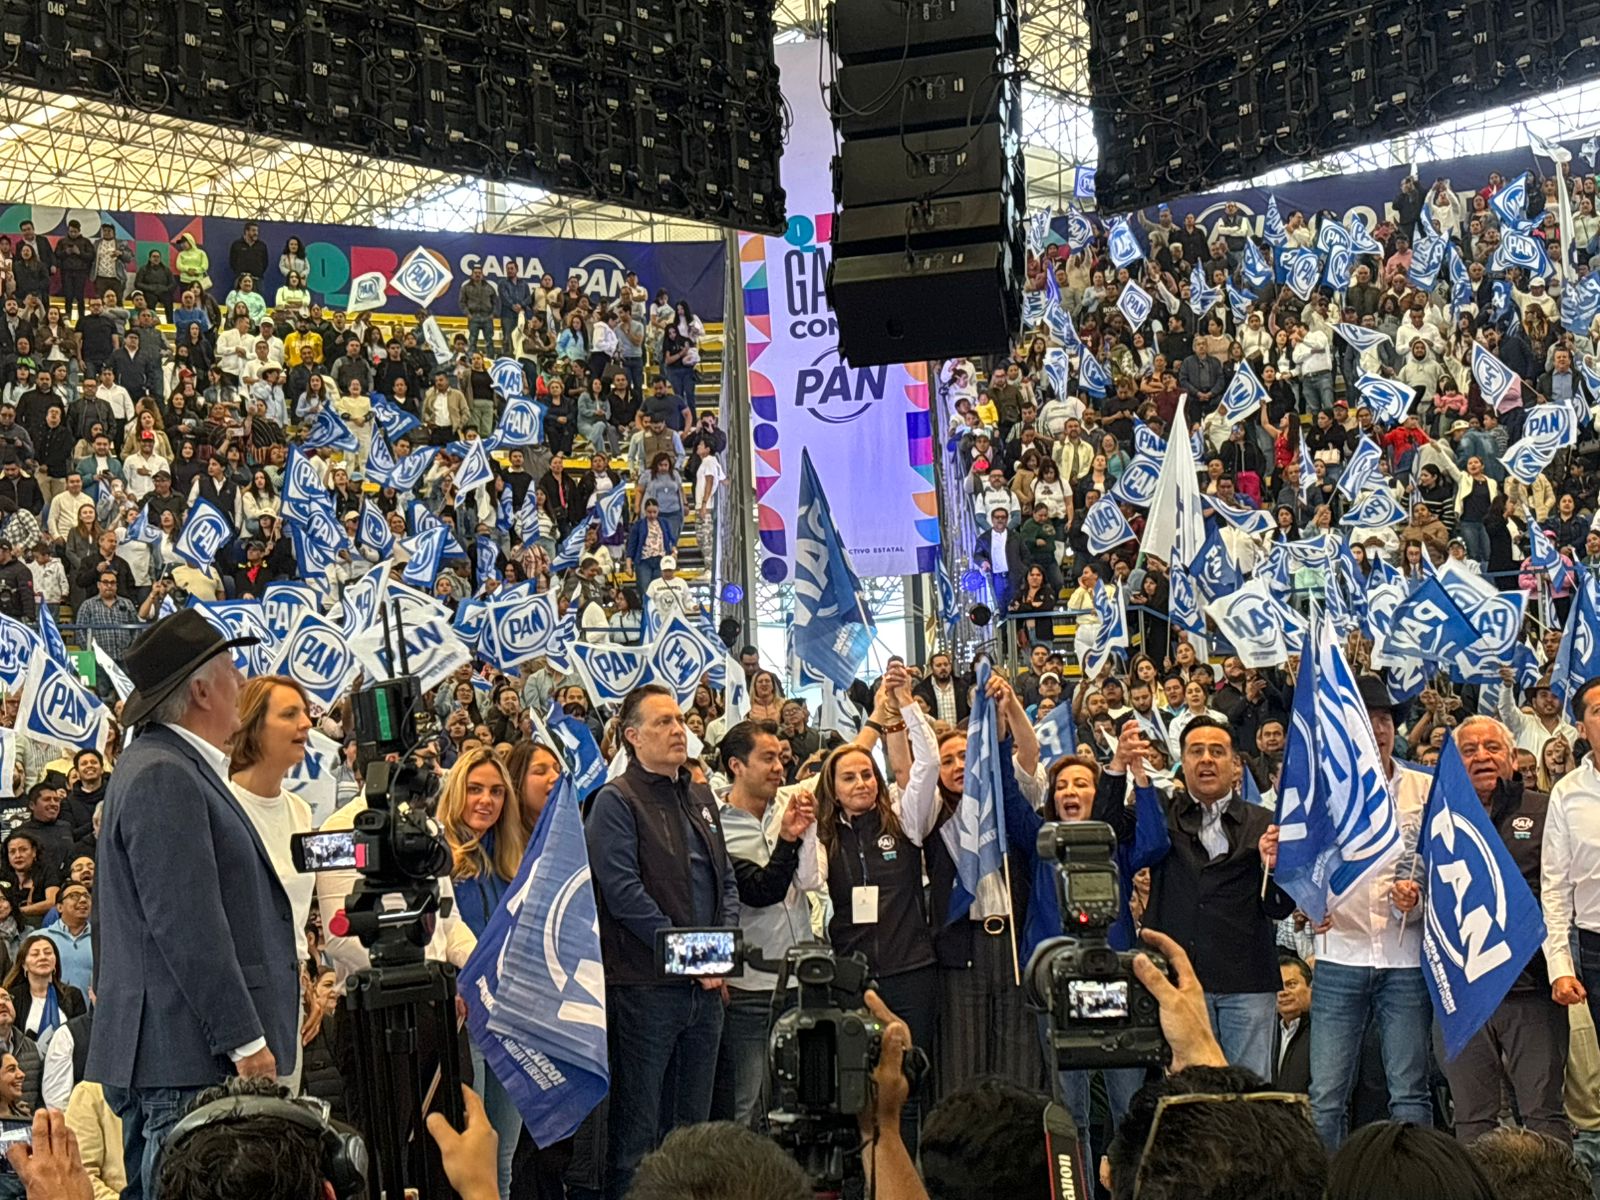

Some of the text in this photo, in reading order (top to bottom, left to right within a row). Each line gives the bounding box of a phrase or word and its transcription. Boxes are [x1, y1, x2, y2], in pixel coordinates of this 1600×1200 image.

[47, 1, 65, 16] 046
[184, 32, 197, 47] 00
[312, 62, 328, 76] 236
[1351, 68, 1366, 82] 272
[430, 89, 445, 102] 011
[1238, 103, 1252, 116] 261
[641, 135, 655, 148] 017
[1132, 134, 1147, 148] 24
[1508, 236, 1533, 257] PAN
[305, 241, 451, 308] QR
[460, 253, 545, 279] GANA
[408, 264, 434, 293] PAN
[567, 267, 631, 297] PAN
[1127, 295, 1147, 319] PAN
[795, 364, 888, 406] PAN
[506, 411, 531, 434] PAN
[1529, 411, 1559, 437] PAN
[1139, 430, 1168, 452] PAN
[308, 515, 334, 546] PAN
[873, 546, 905, 554] ESTATAL
[508, 600, 546, 644] PAN
[295, 634, 342, 680] PAN
[594, 651, 638, 682] PAN
[46, 681, 88, 729] PAN
[1430, 797, 1513, 984] PAN
